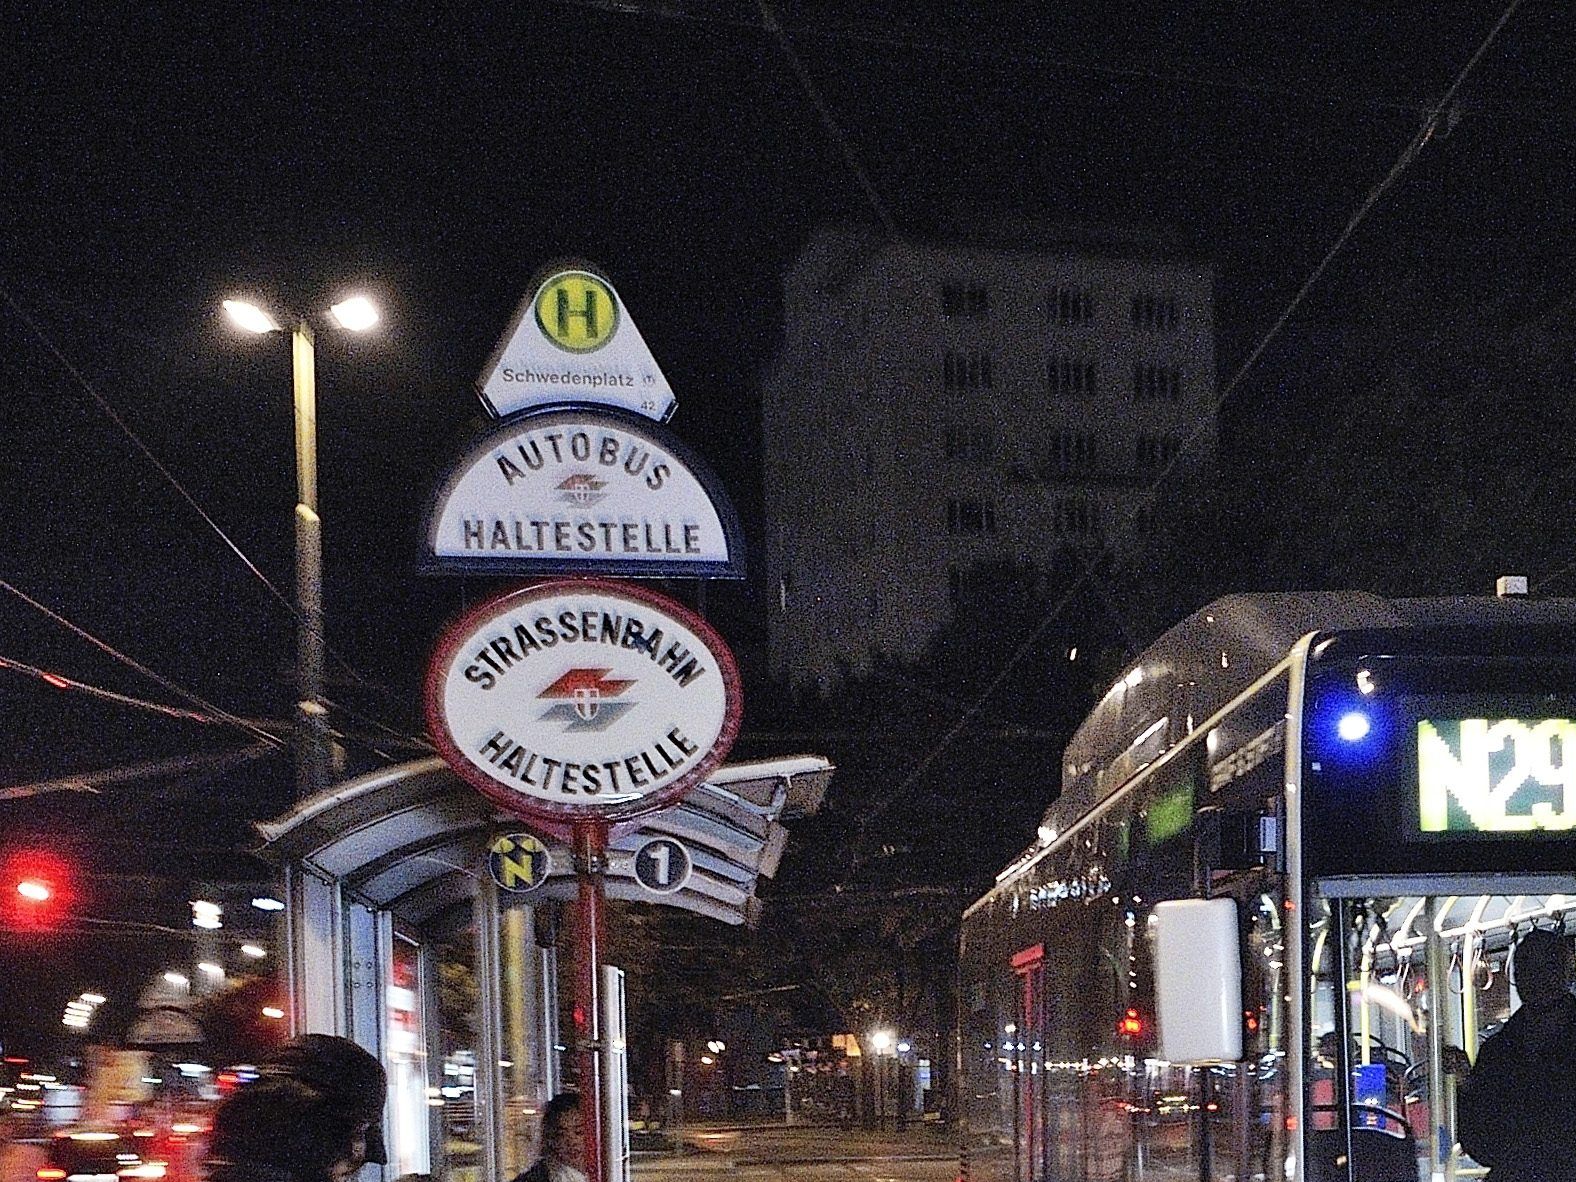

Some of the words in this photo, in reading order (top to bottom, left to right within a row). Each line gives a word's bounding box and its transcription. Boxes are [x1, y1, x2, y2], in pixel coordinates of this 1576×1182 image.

[557, 288, 599, 339] H
[502, 368, 635, 388] Schwedenplatz
[496, 431, 672, 491] AUTOBUS
[463, 519, 701, 554] HALTESTELLE
[464, 610, 706, 691] STRASSENBAHN
[478, 726, 700, 795] HALTESTELLE
[650, 845, 670, 885] 1
